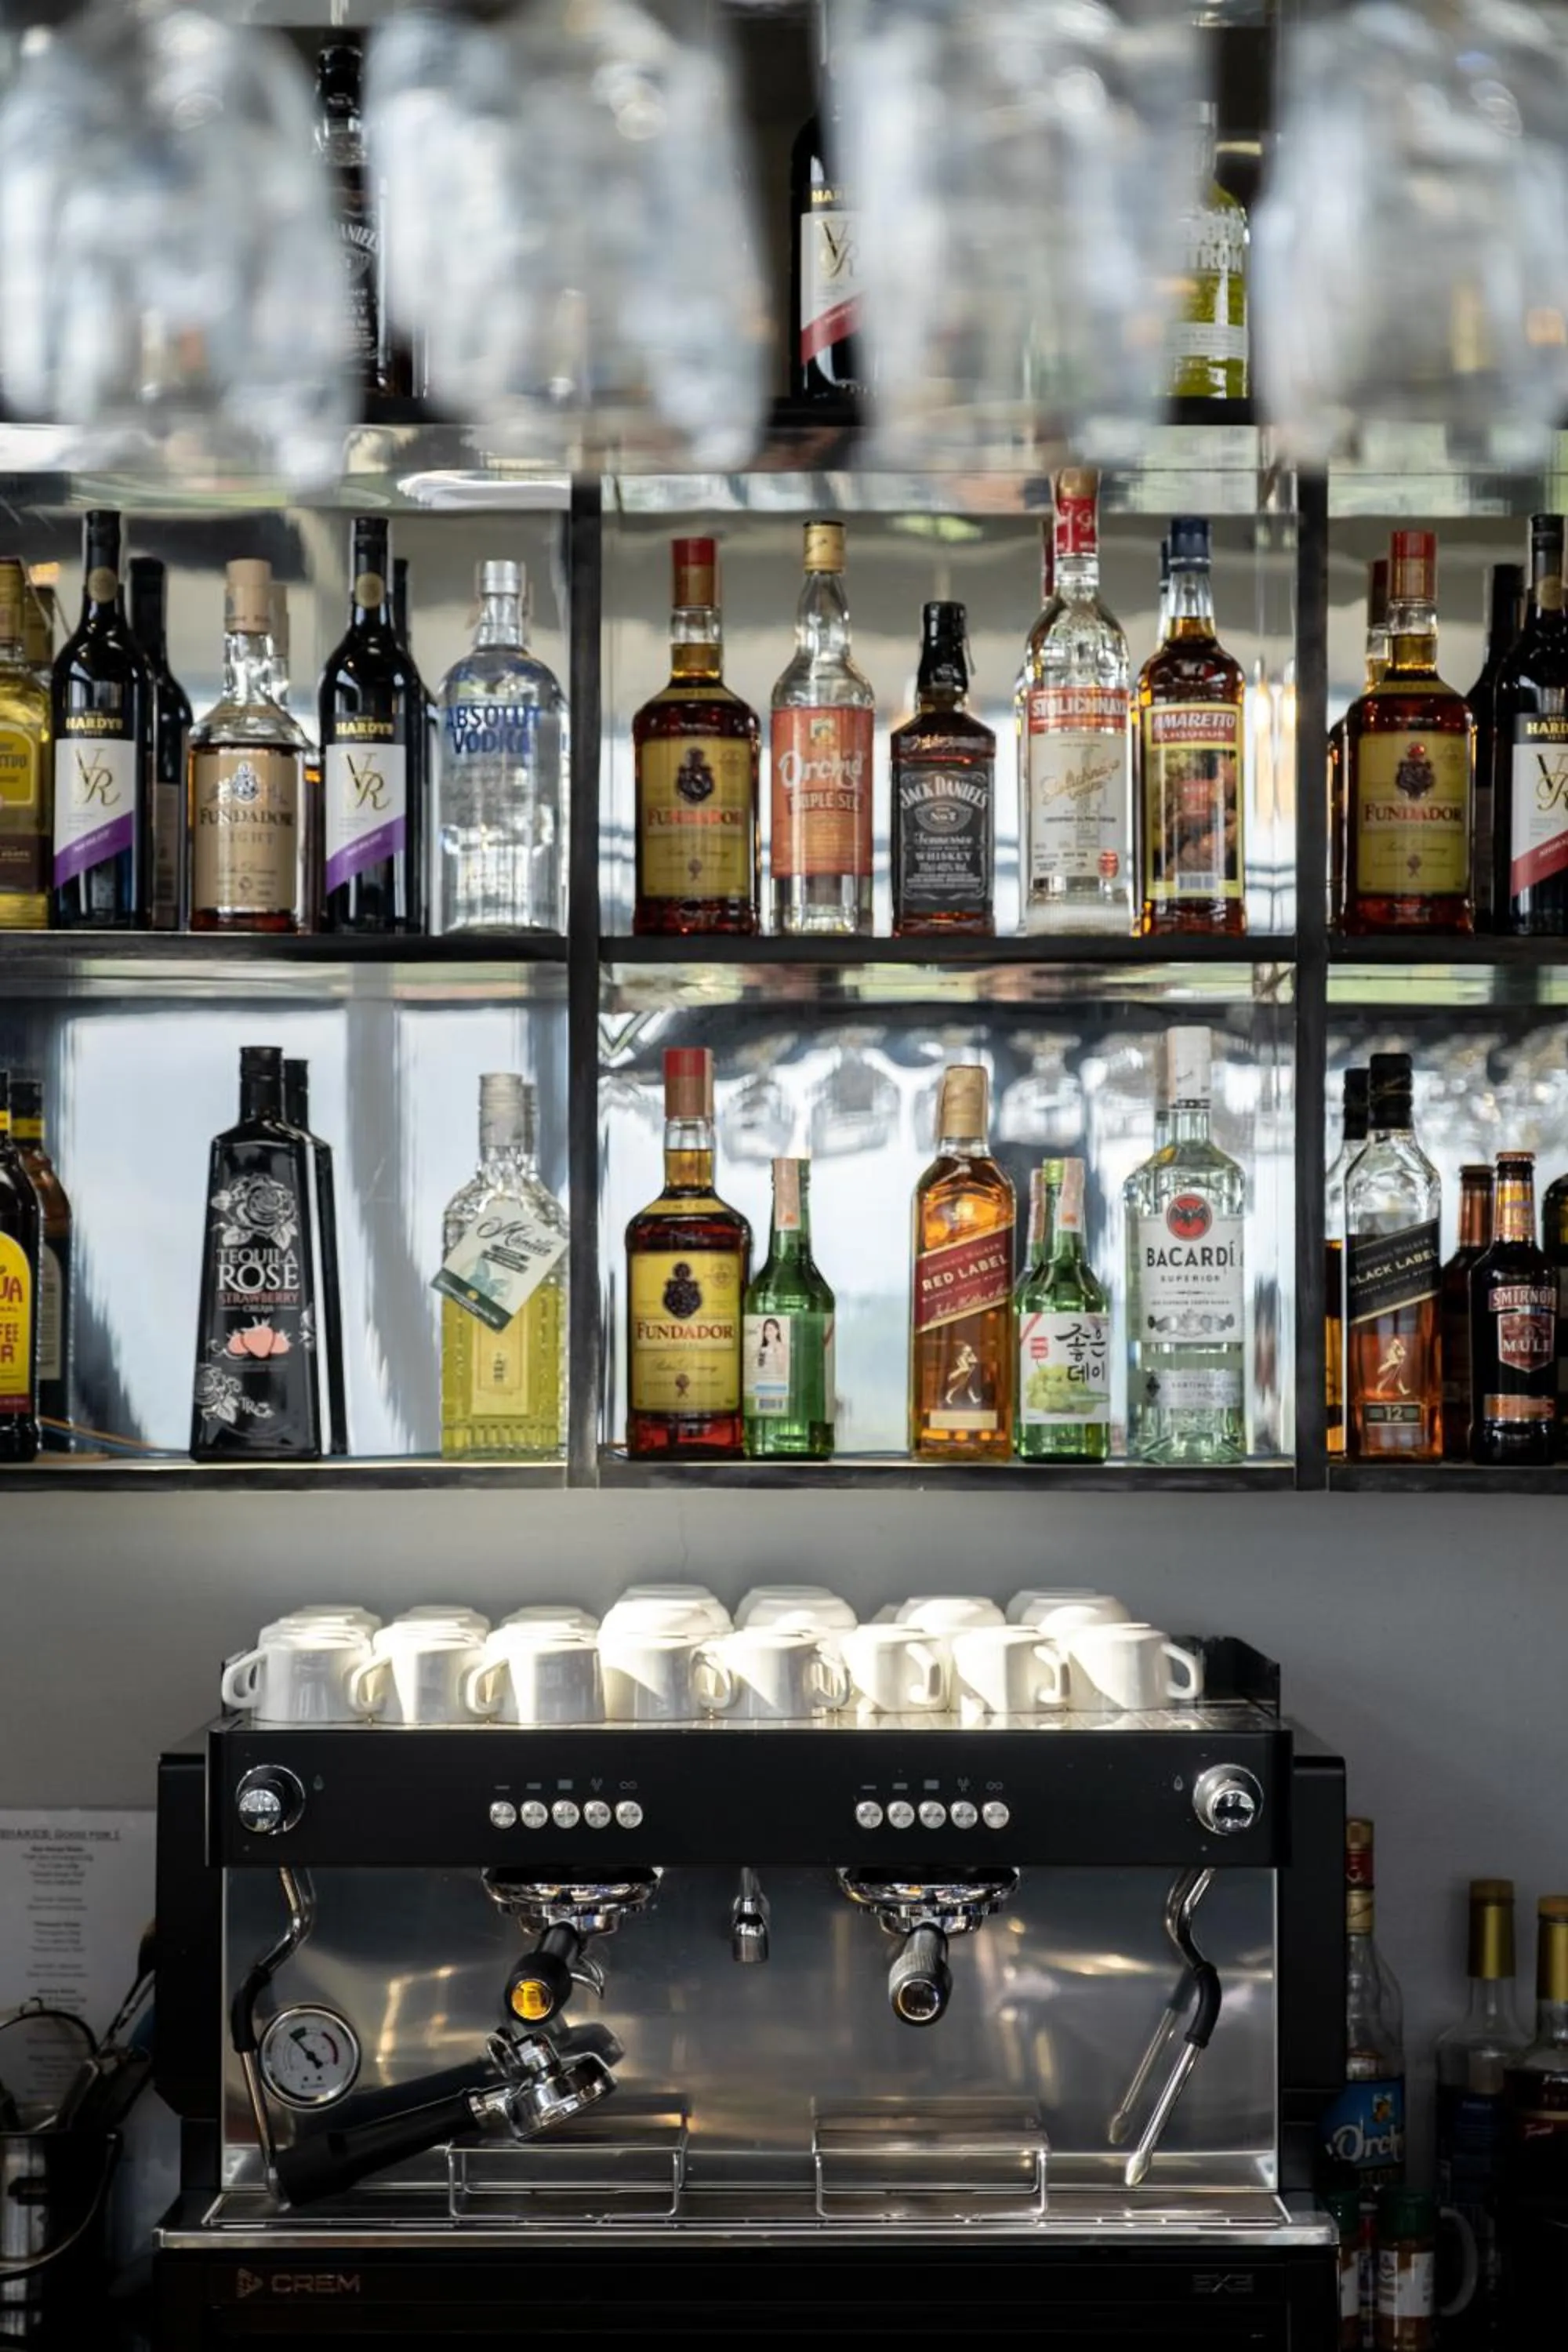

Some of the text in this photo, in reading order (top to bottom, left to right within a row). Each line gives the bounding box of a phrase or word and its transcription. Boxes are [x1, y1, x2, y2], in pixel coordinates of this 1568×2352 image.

[446, 705, 541, 730] ABSOLUT
[1154, 713, 1236, 729] AMARETTO
[1526, 722, 1568, 735] HARD
[453, 729, 531, 754] VODKA
[899, 782, 934, 809] JACK
[200, 808, 293, 826] FUNDADOR
[1363, 804, 1462, 822] FUNDADOR
[216, 1247, 298, 1265] TEQUILA
[1146, 1240, 1235, 1267] BACARDÍ
[219, 1264, 300, 1293] ROSE
[922, 1272, 954, 1291] RED
[958, 1254, 1007, 1279] LABEL
[1160, 1274, 1220, 1283] SUPERIOR
[219, 1292, 299, 1305] STRAWBERRY
[637, 1322, 735, 1340] FUNDADOR
[1067, 1359, 1105, 1383] 데이
[1385, 1406, 1403, 1421] 12
[1324, 2114, 1405, 2163] Orch
[270, 2274, 361, 2293] CREM
